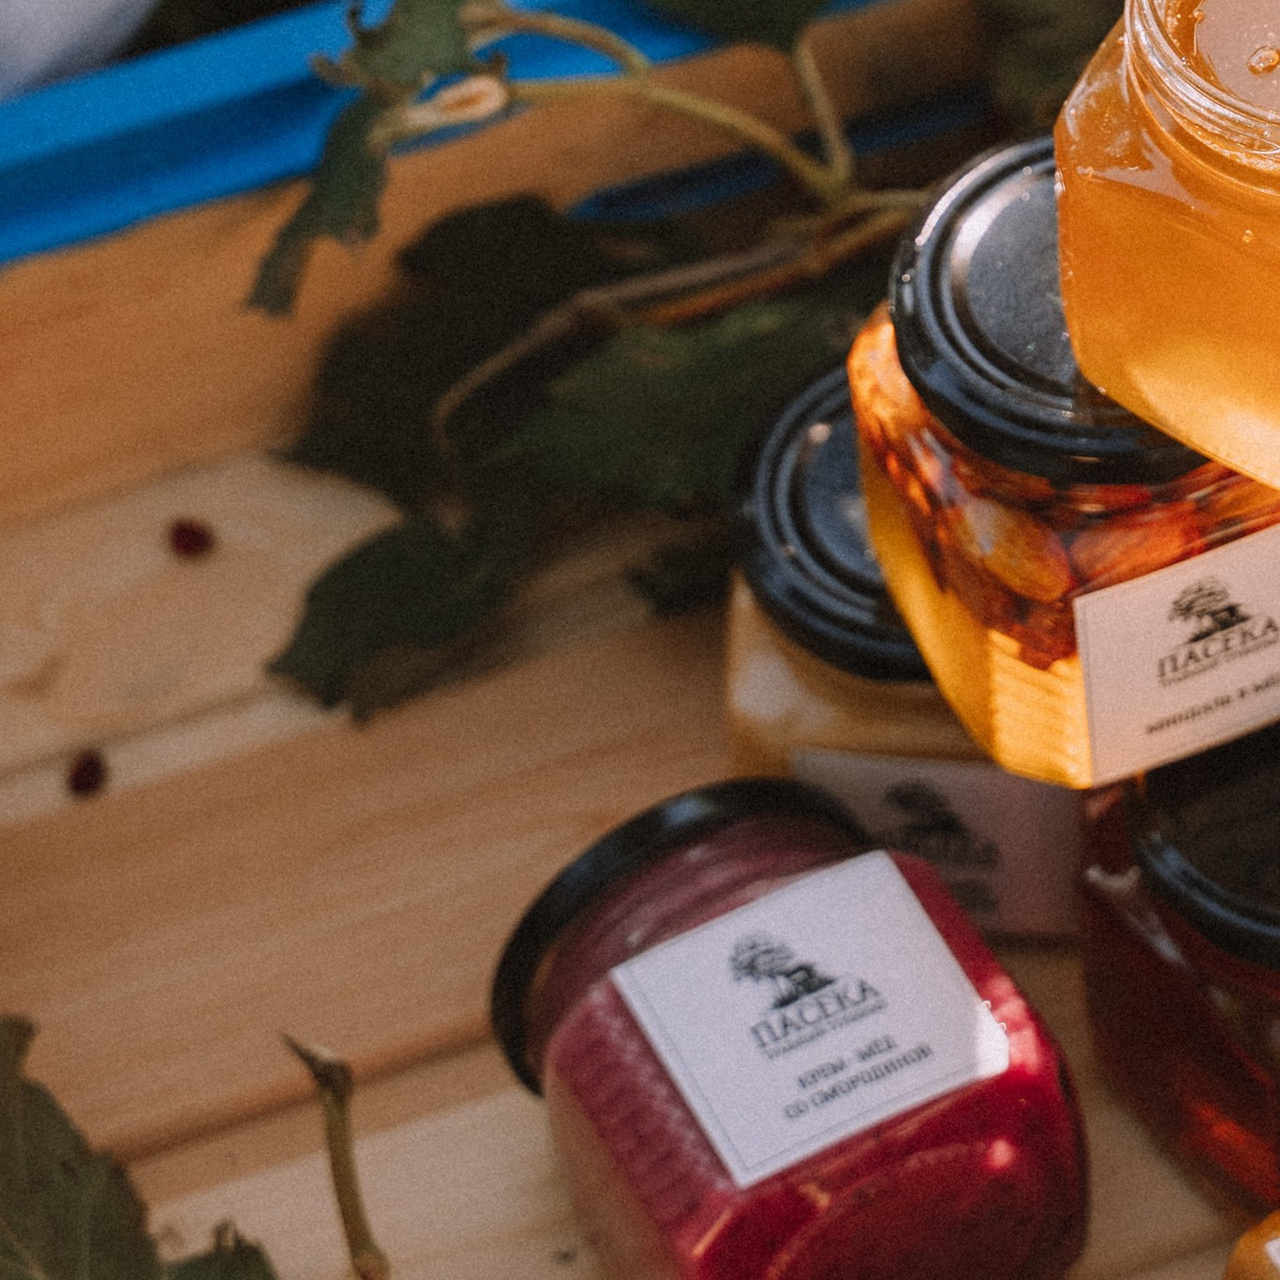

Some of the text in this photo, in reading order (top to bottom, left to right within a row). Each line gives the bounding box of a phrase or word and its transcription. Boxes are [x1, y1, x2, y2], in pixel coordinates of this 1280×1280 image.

[1158, 617, 1280, 677] ПАСЕКА
[750, 979, 880, 1048] ПАСЕКА
[784, 1099, 809, 1119] СО
